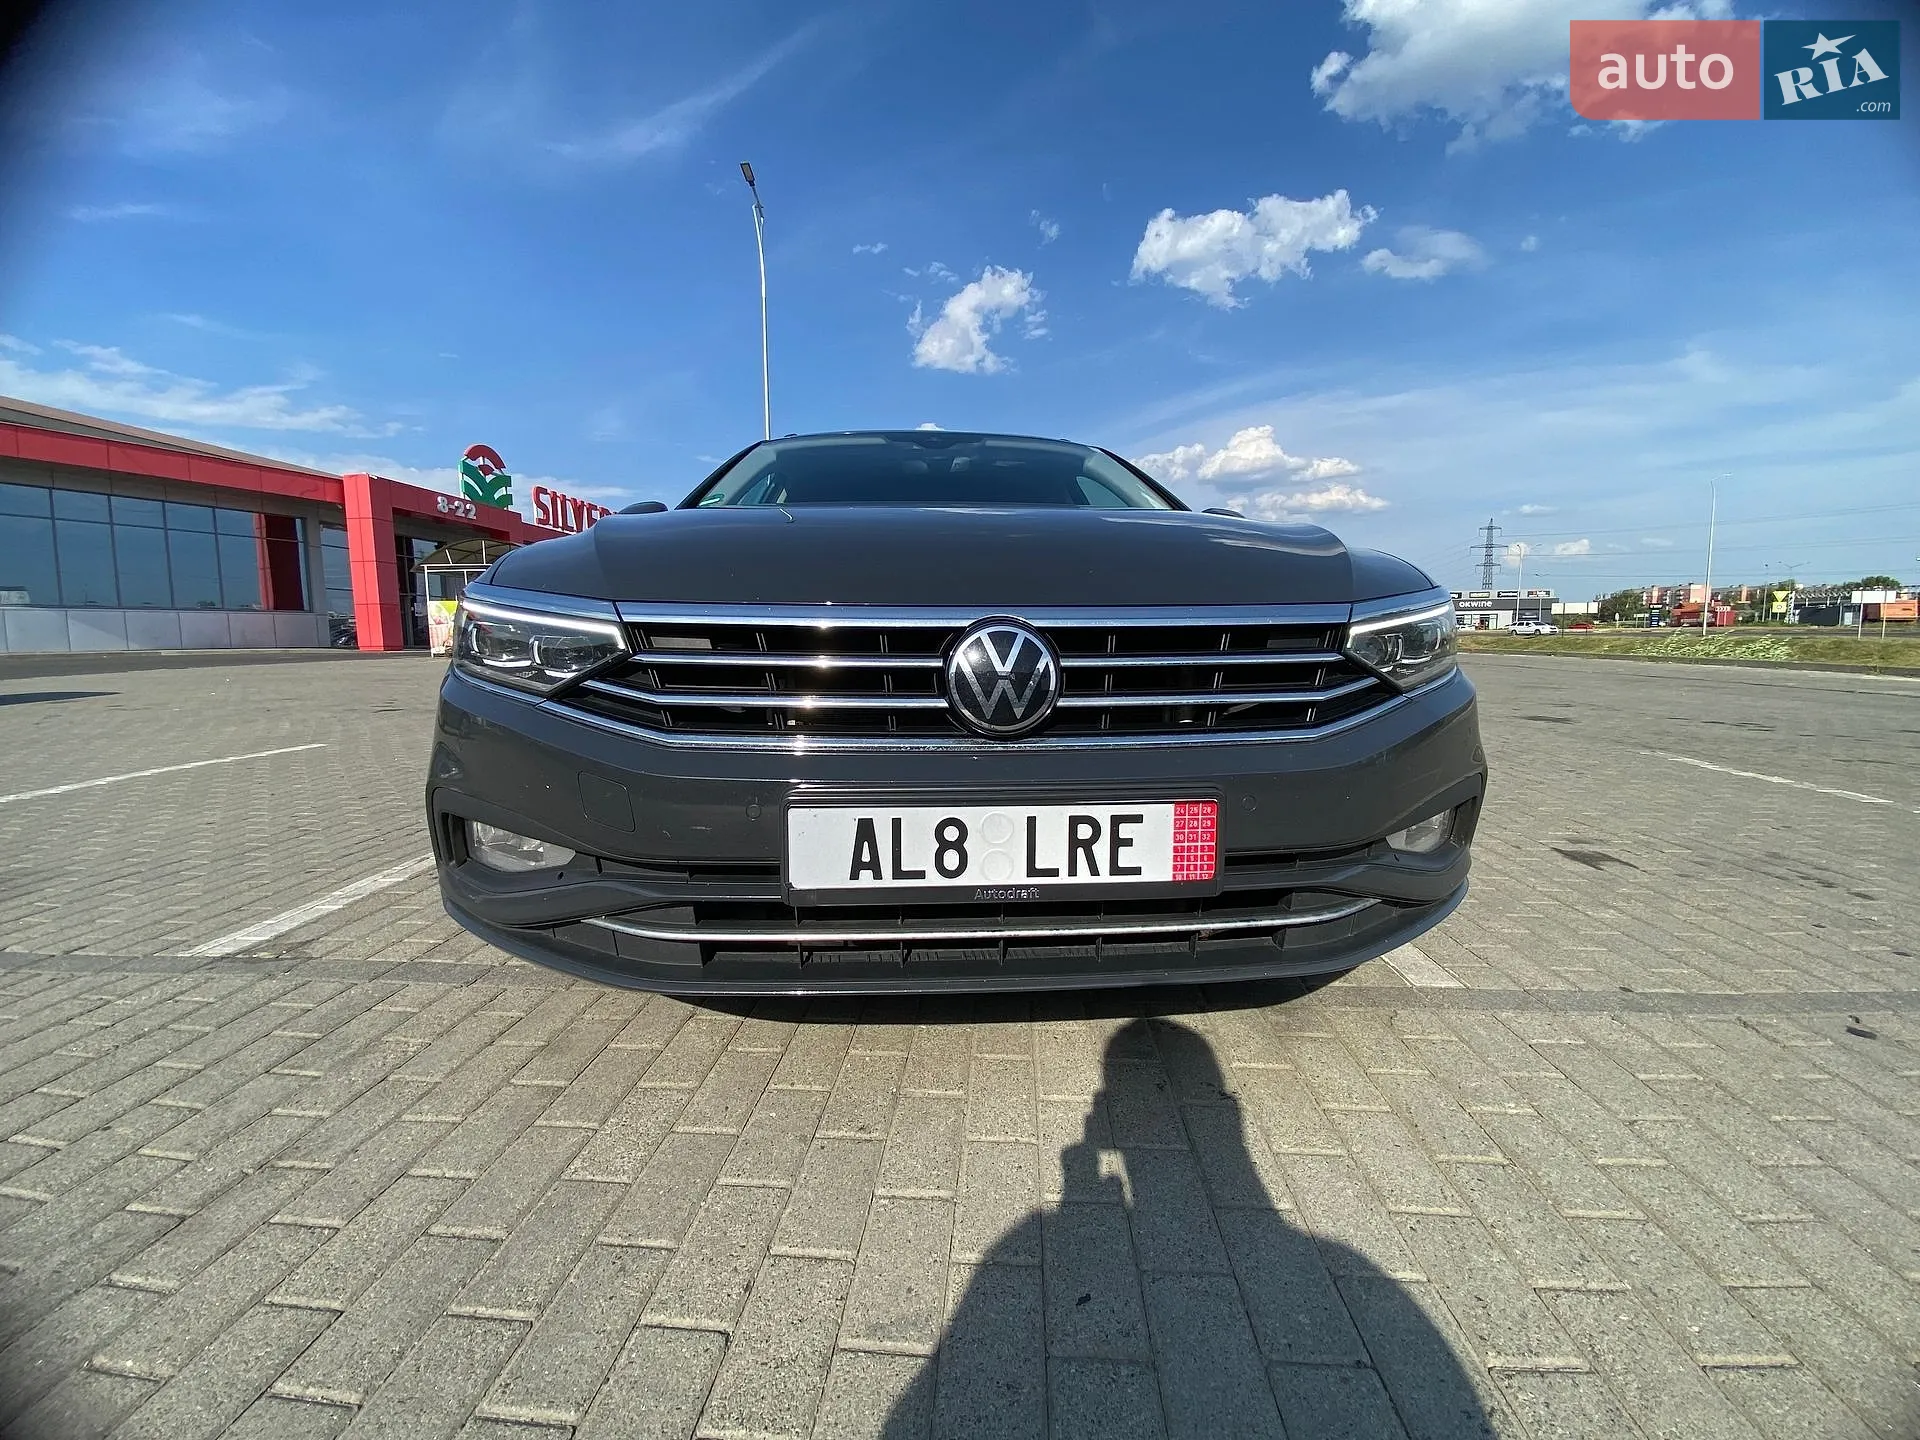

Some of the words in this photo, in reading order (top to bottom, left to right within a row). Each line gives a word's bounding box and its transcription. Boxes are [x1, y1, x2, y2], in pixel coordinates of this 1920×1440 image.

[437, 496, 476, 519] 8-22
[849, 817, 968, 880] AL8
[1026, 814, 1143, 877] LRE
[974, 887, 1040, 900] Autodraft
